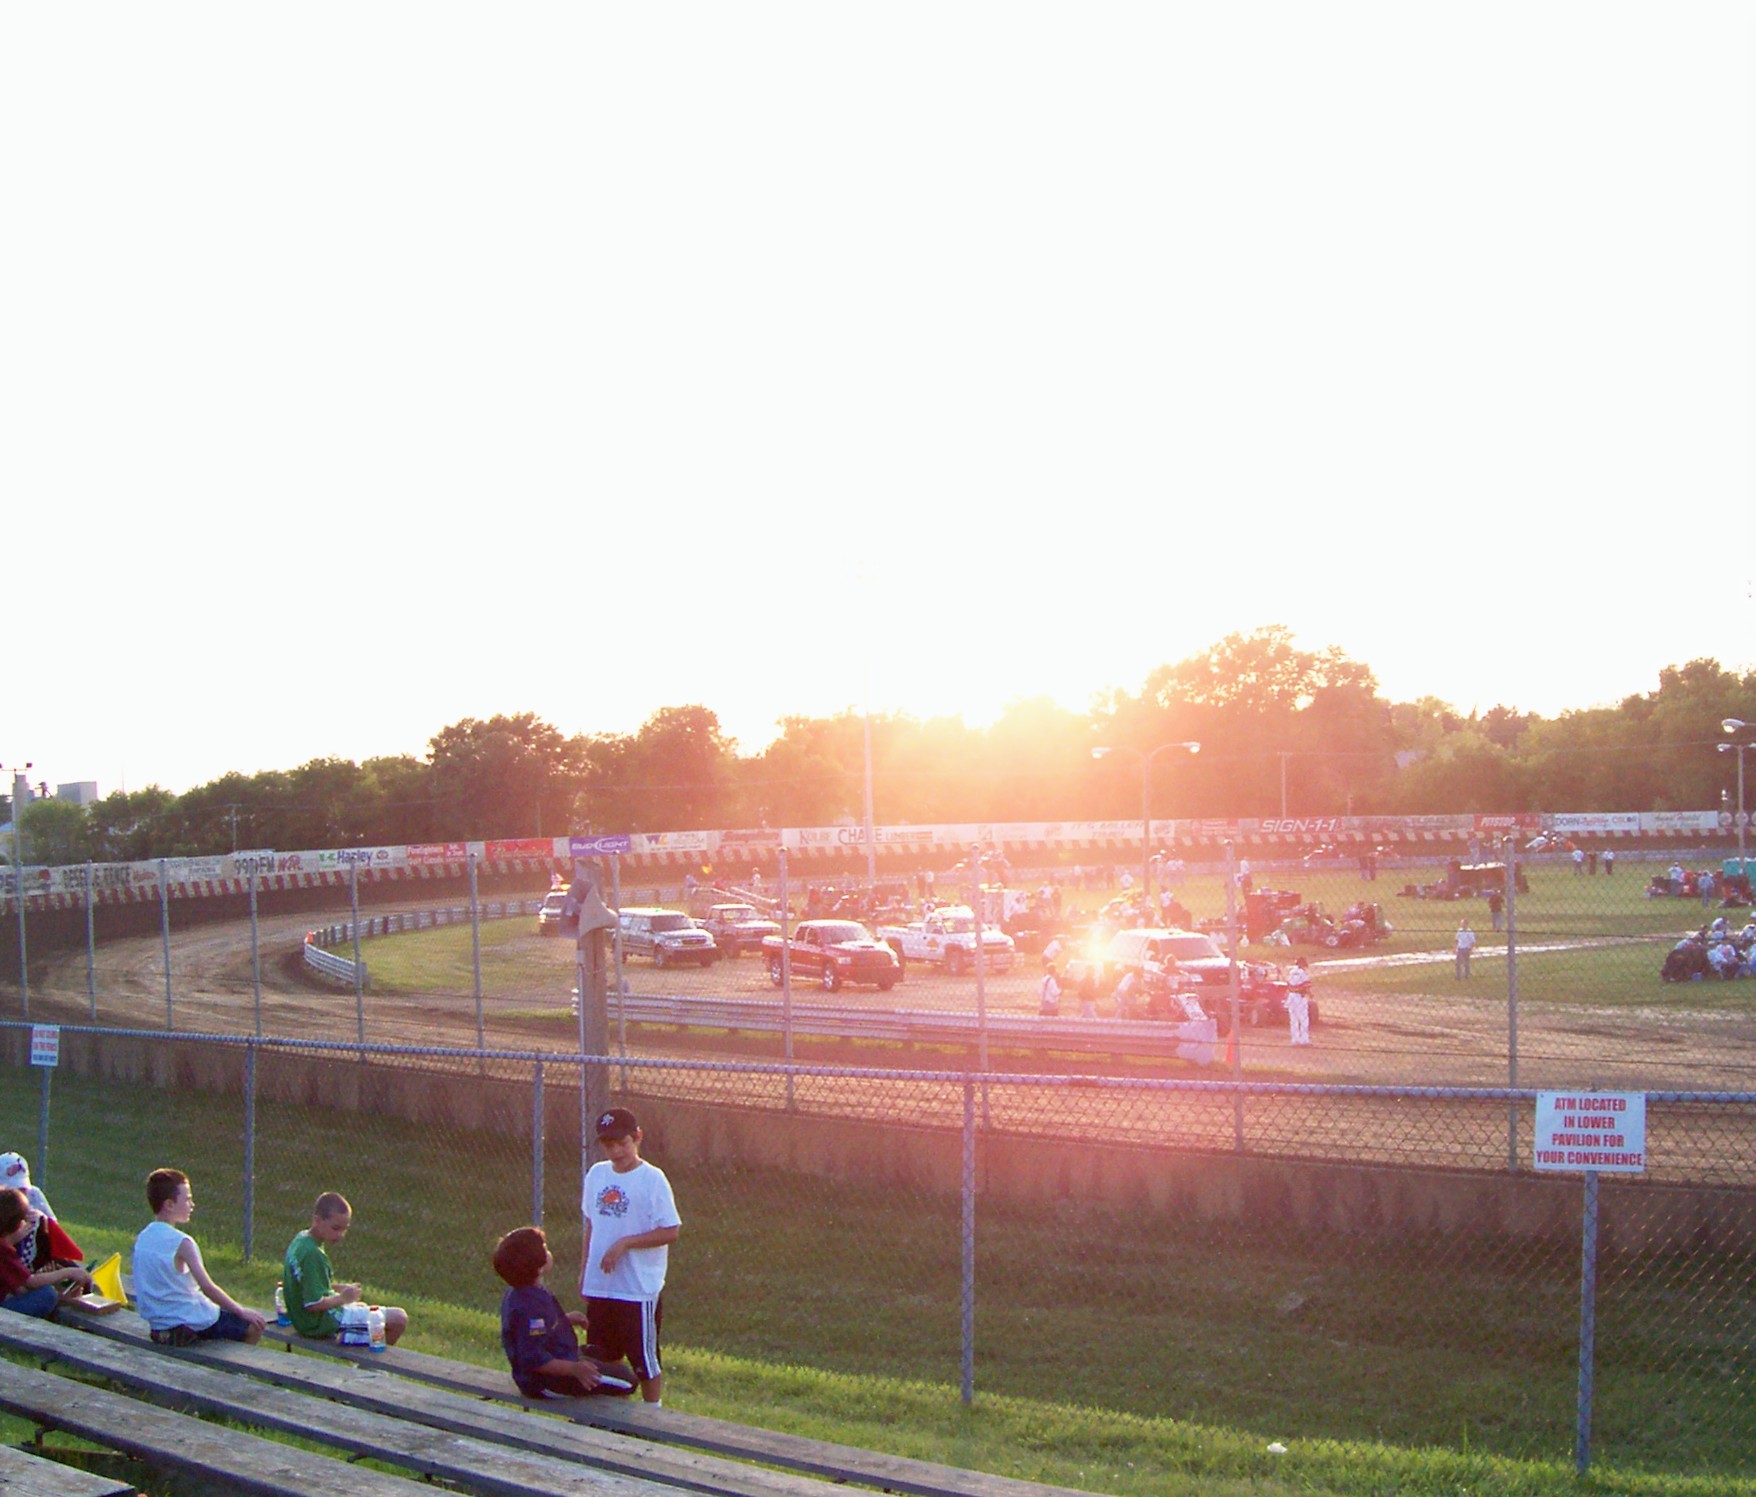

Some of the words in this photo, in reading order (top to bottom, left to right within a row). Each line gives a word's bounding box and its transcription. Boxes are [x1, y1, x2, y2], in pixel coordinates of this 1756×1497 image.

[838, 829, 883, 845] CHAE
[600, 840, 629, 850] LIGHT
[1554, 1097, 1577, 1110] ATM
[1579, 1098, 1627, 1112] LOCATED
[1564, 1116, 1575, 1128] IN
[1578, 1116, 1616, 1129] LOWER
[1552, 1133, 1601, 1147] PAVILION
[1603, 1135, 1624, 1147] FOR
[1536, 1151, 1565, 1164] YOUR
[1567, 1152, 1642, 1166] CONVENIENCE
